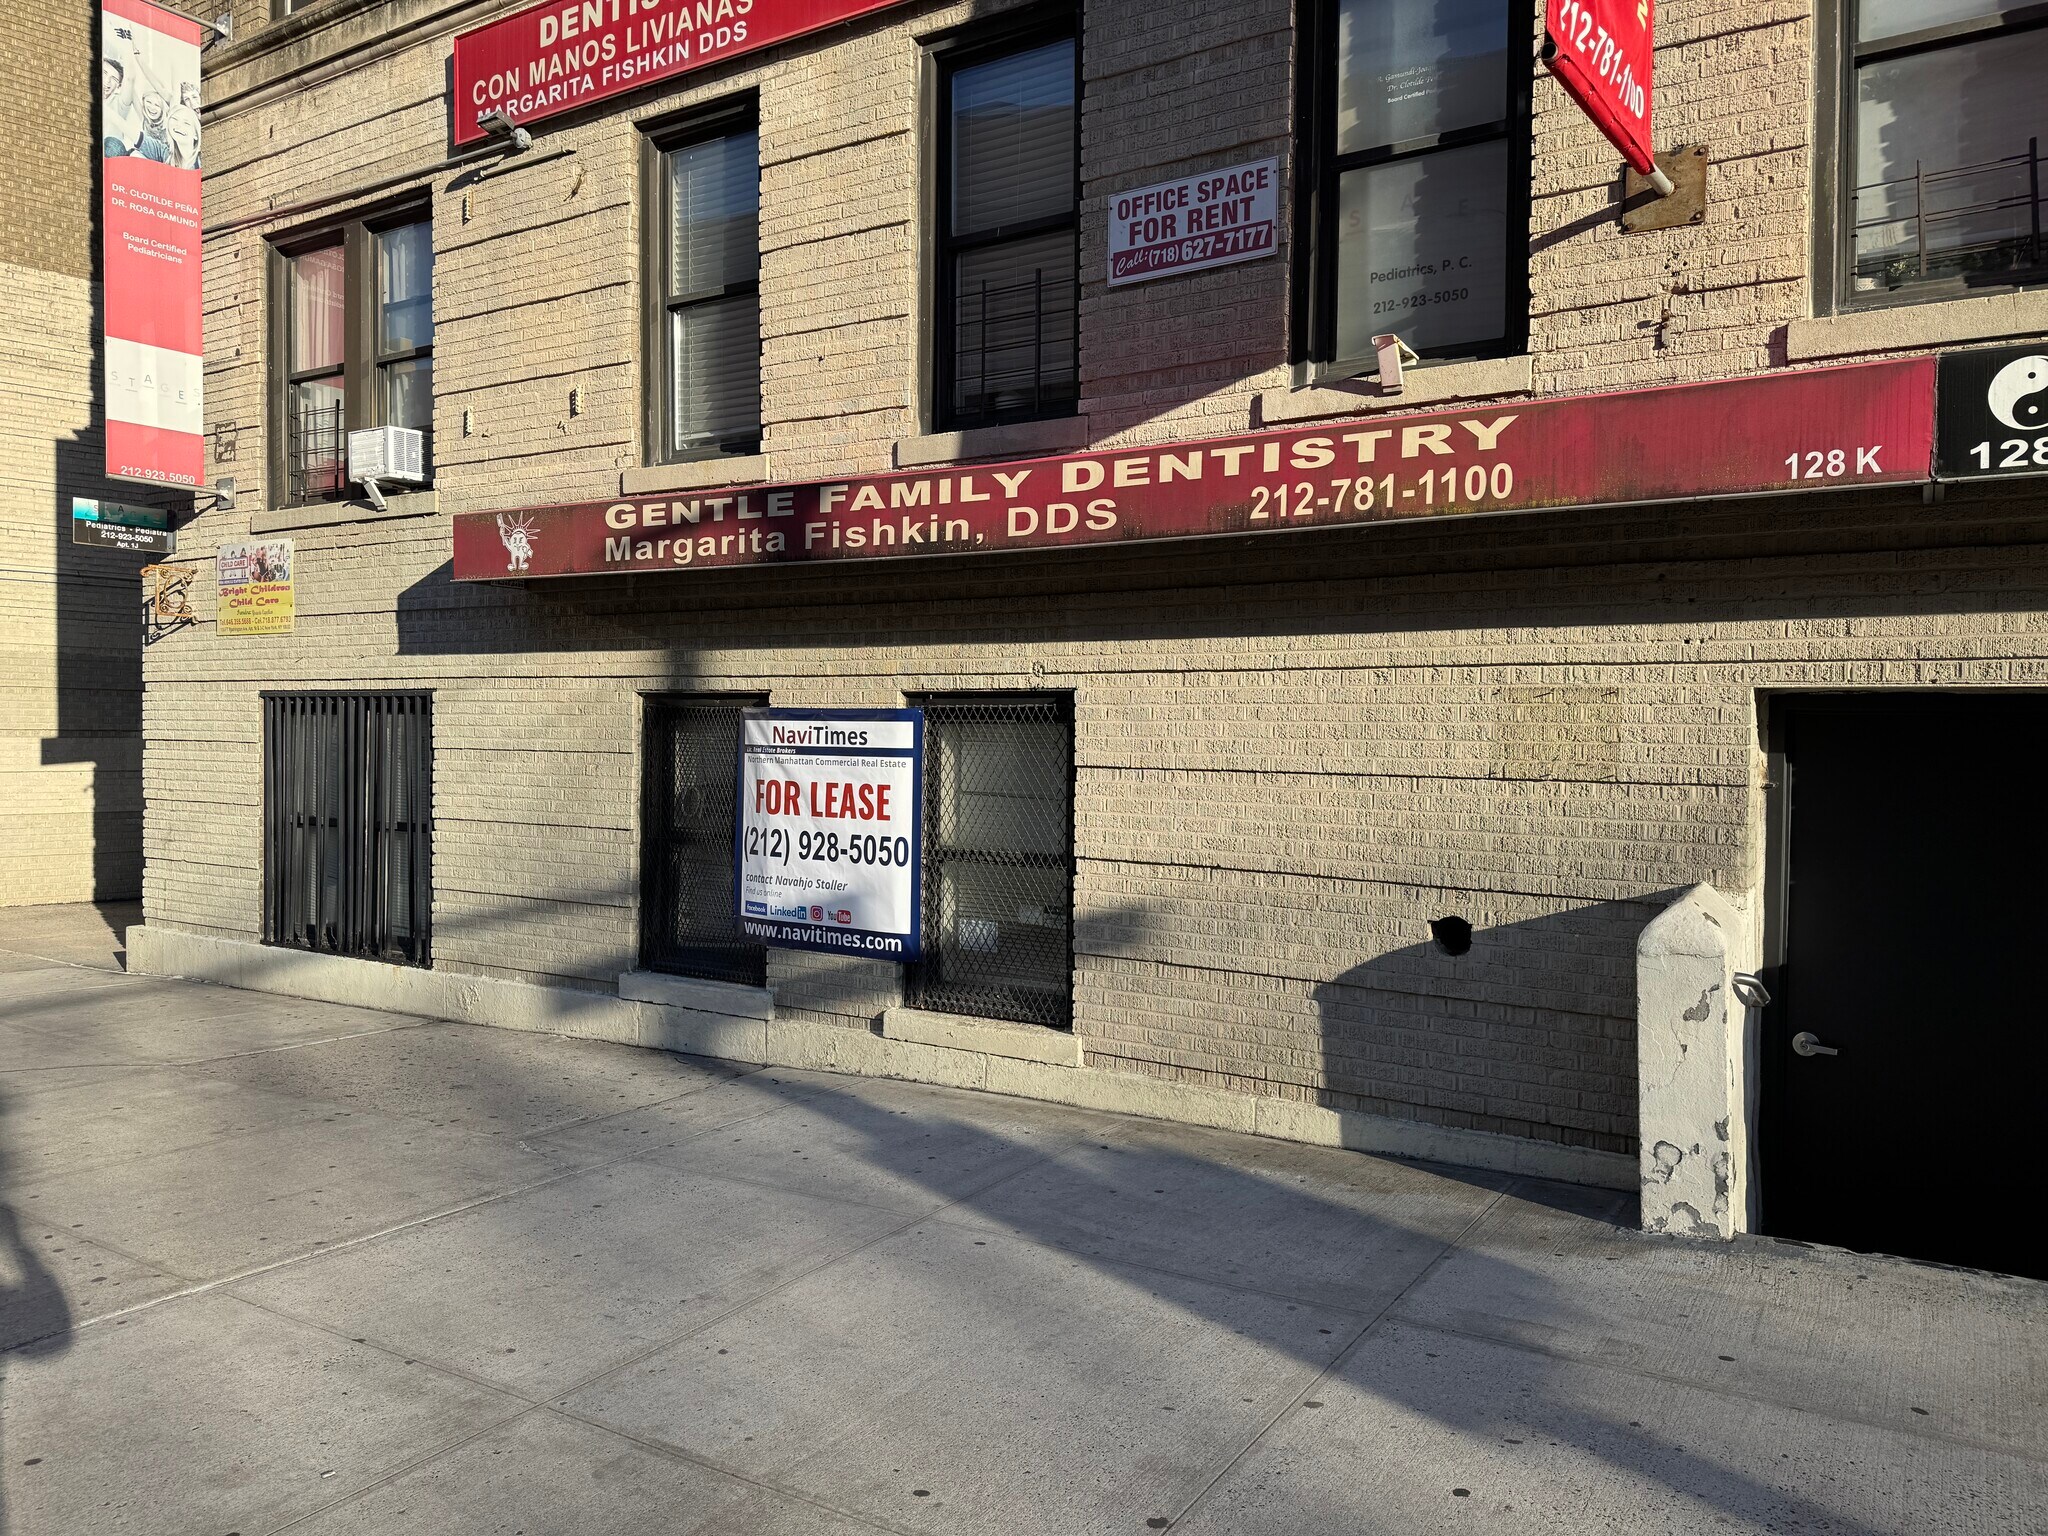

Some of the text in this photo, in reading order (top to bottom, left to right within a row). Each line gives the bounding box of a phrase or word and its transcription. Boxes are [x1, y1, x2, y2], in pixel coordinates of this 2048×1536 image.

[472, 0, 753, 105] CON MANOS LIVIANAS
[602, 39, 689, 86] FISHKIN
[700, 21, 748, 54] DDS
[112, 184, 198, 216] DR. CLOTILDE PEÑA
[1118, 166, 1268, 220] OFFICE SPACE
[112, 198, 198, 228] DR. ROSA GAMUNDI
[1130, 195, 1255, 246] FOR RENT
[122, 232, 187, 255] Board Certified
[128, 243, 182, 264] Pediatricians
[1116, 250, 1148, 276] Call:
[1370, 264, 1437, 284] Pediatrics,
[1373, 288, 1469, 314] 212-923-5050
[120, 466, 195, 484] 212.923.5050
[604, 414, 1519, 530] GENTLE FAMILY DENTISTRY
[1784, 445, 1882, 480] 128 K
[1249, 462, 1514, 520] 212-781-1100
[86, 521, 126, 532] Pediatrics
[100, 530, 154, 543] 212-923-5050
[605, 498, 1117, 564] Margarita Fishkin, DDS
[218, 587, 247, 597] Bright
[229, 598, 252, 608] Child
[772, 726, 868, 746] NaviTimes
[748, 756, 907, 768] Northern Manhattan Commercial Real Estate
[756, 779, 891, 821] FOR LEASE
[744, 826, 909, 867] (212) 928-5050
[746, 873, 848, 892] contact Navahjo Stoller
[764, 888, 782, 898] online
[746, 904, 766, 913] facebook
[744, 921, 902, 952] www.navitimes.com
